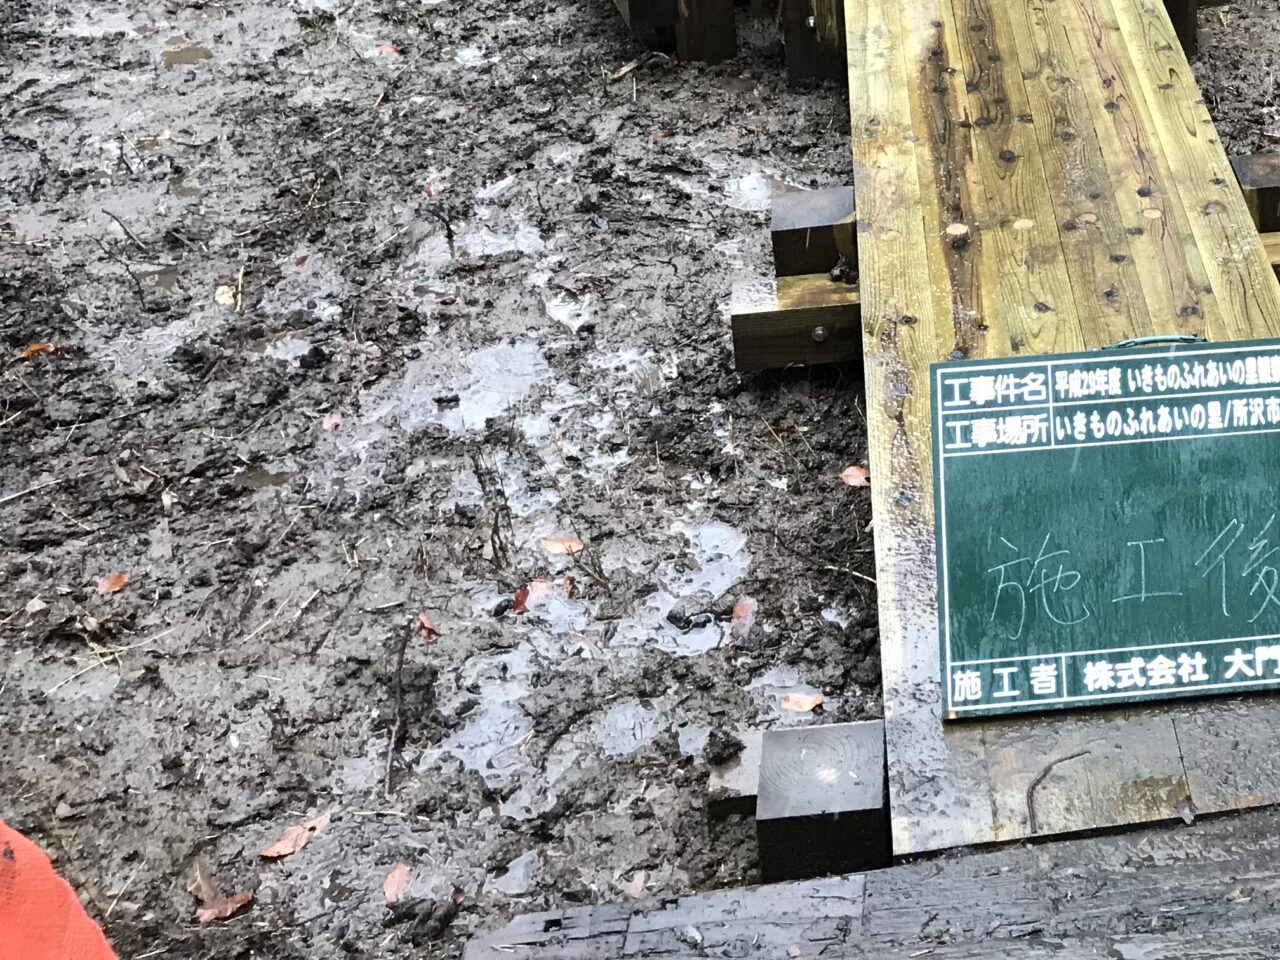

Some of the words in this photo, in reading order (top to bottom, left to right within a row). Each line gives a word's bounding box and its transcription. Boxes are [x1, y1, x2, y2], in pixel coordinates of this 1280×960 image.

[944, 372, 1046, 406] 工事件名
[1055, 366, 1122, 398] 平成29年度
[945, 413, 1048, 448] 工事場所
[953, 663, 1057, 702] 施工者
[1083, 652, 1208, 692] 株式会社
